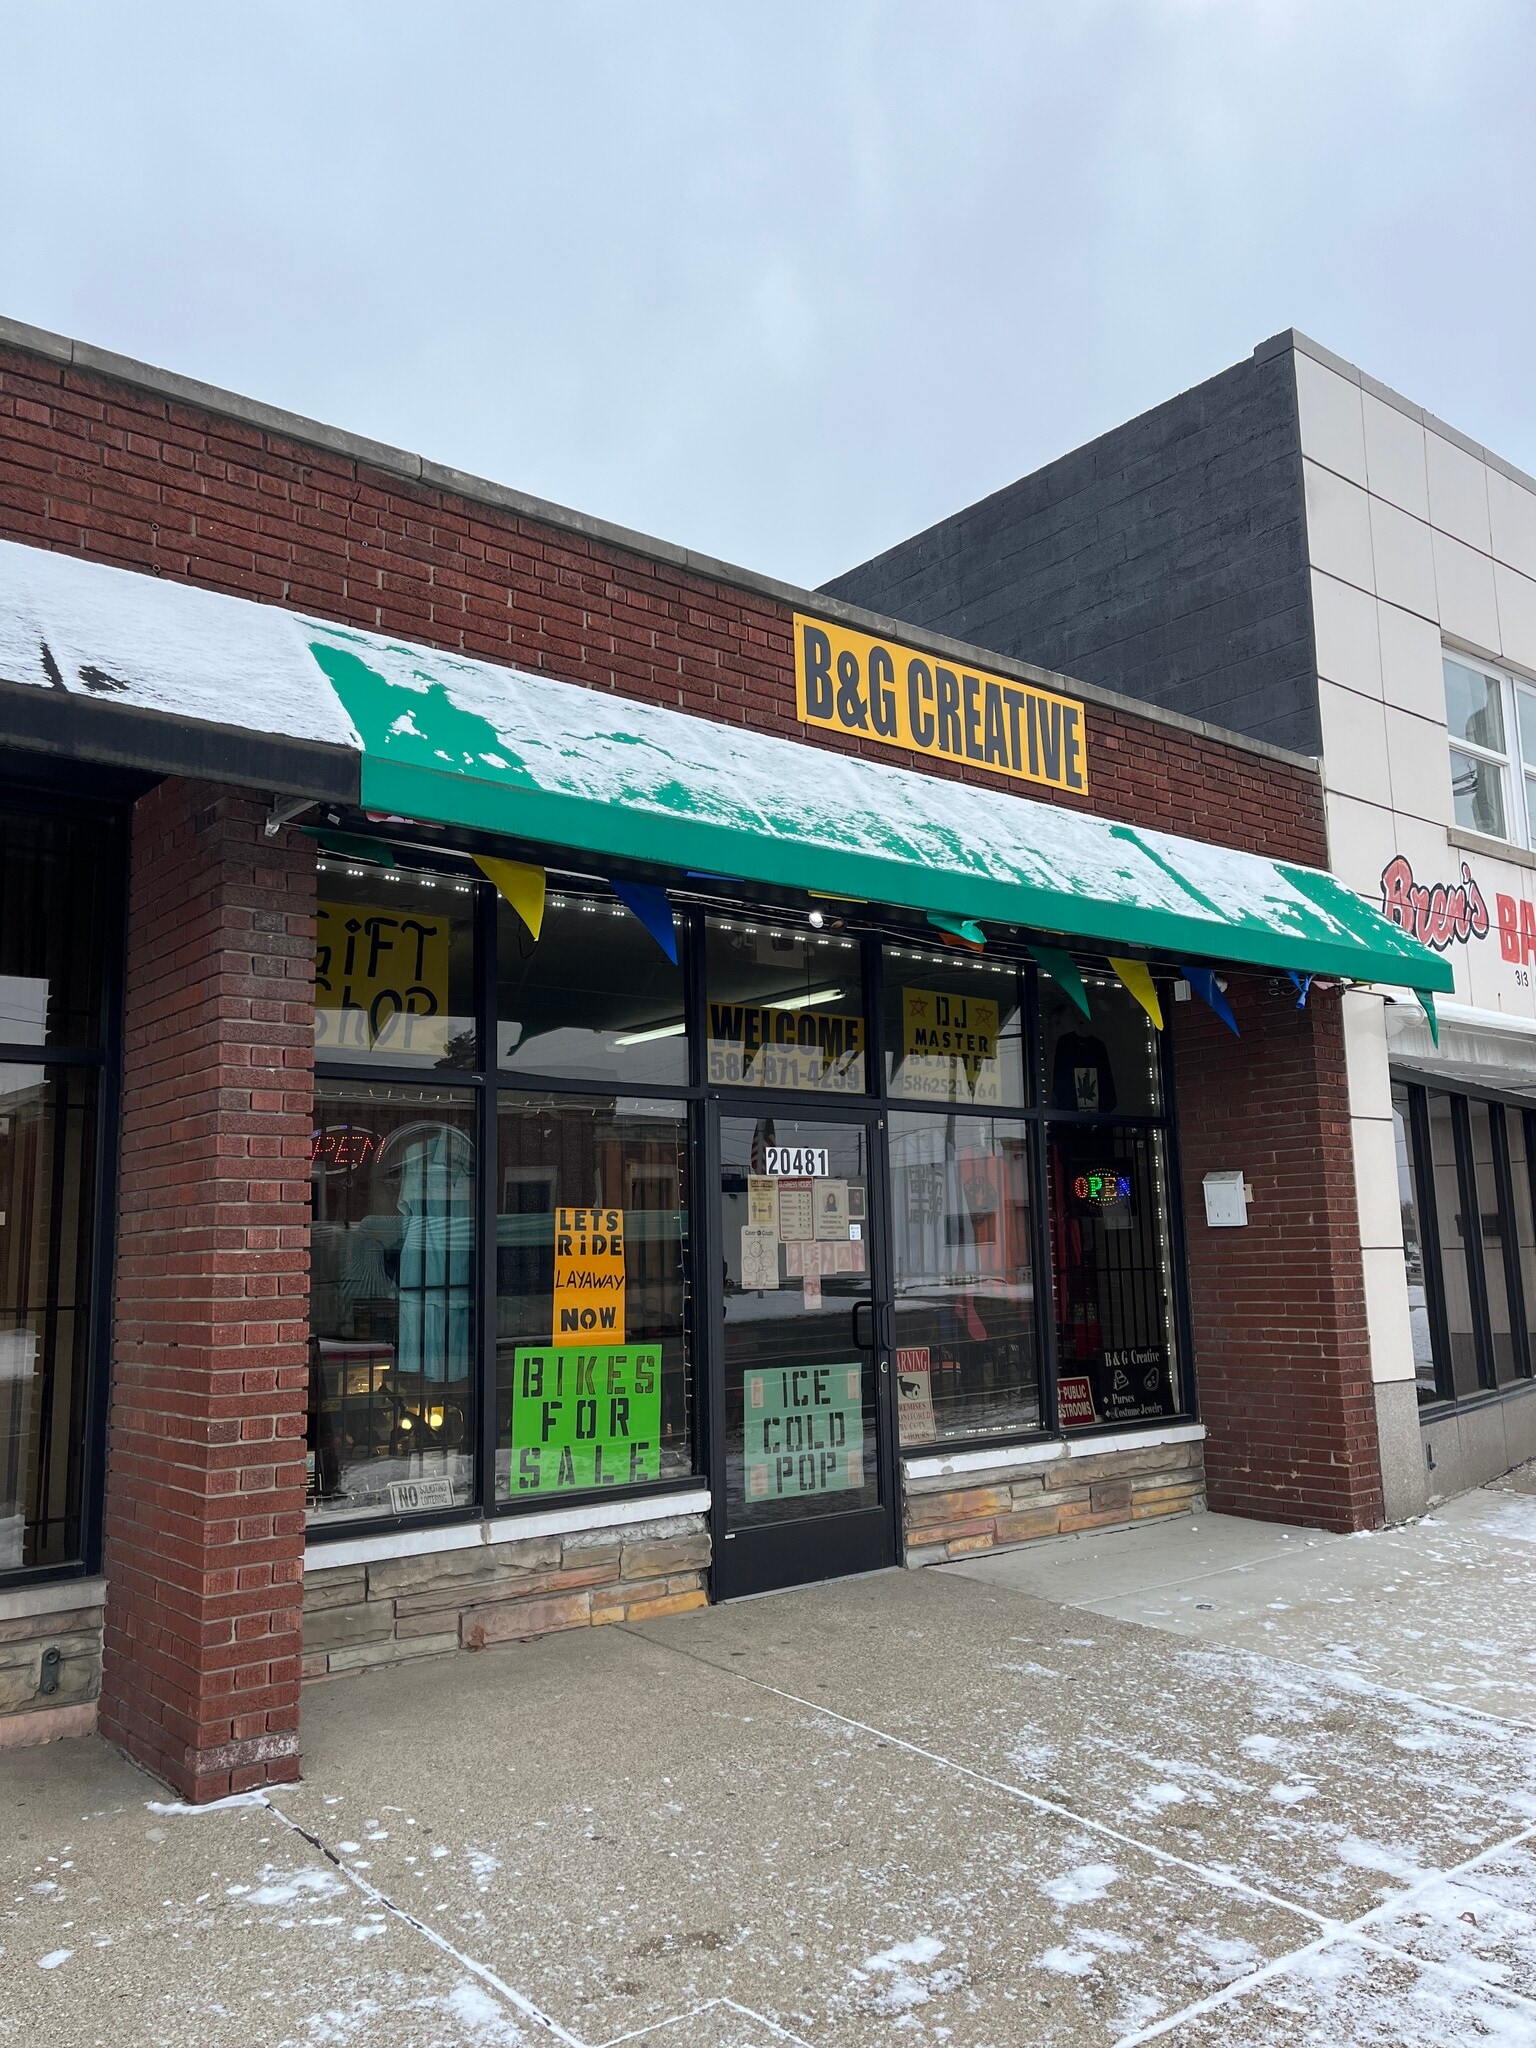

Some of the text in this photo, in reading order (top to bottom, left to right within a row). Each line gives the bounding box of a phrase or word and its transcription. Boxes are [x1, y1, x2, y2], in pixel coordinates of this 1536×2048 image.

[803, 624, 1083, 789] B&G CREATIVE
[1380, 855, 1489, 952] Bren's
[1515, 970, 1529, 987] 313
[936, 995, 967, 1028] DJ
[710, 1004, 859, 1059] WELCOME
[915, 1028, 989, 1052] MASTER
[909, 1048, 996, 1074] BLASTER
[311, 1136, 386, 1163] PEN
[767, 1148, 826, 1175] 20481
[1074, 1176, 1131, 1198] OPEN
[559, 1209, 619, 1232] LETS
[555, 1269, 625, 1291] LAYAWAY
[896, 1350, 927, 1372] ARNING
[1131, 1348, 1160, 1365] Creative
[522, 1355, 655, 1398] BIKES
[782, 1369, 831, 1408] ICE
[1063, 1384, 1086, 1400] PUBLIC
[1111, 1393, 1135, 1405] Purses
[541, 1398, 630, 1442] FOR
[899, 1402, 927, 1412] REMISES
[1058, 1401, 1092, 1418] ESTROOMS
[763, 1411, 846, 1454] COLD
[518, 1441, 650, 1489] SALE
[776, 1452, 837, 1494] POP
[399, 1485, 418, 1508] NO
